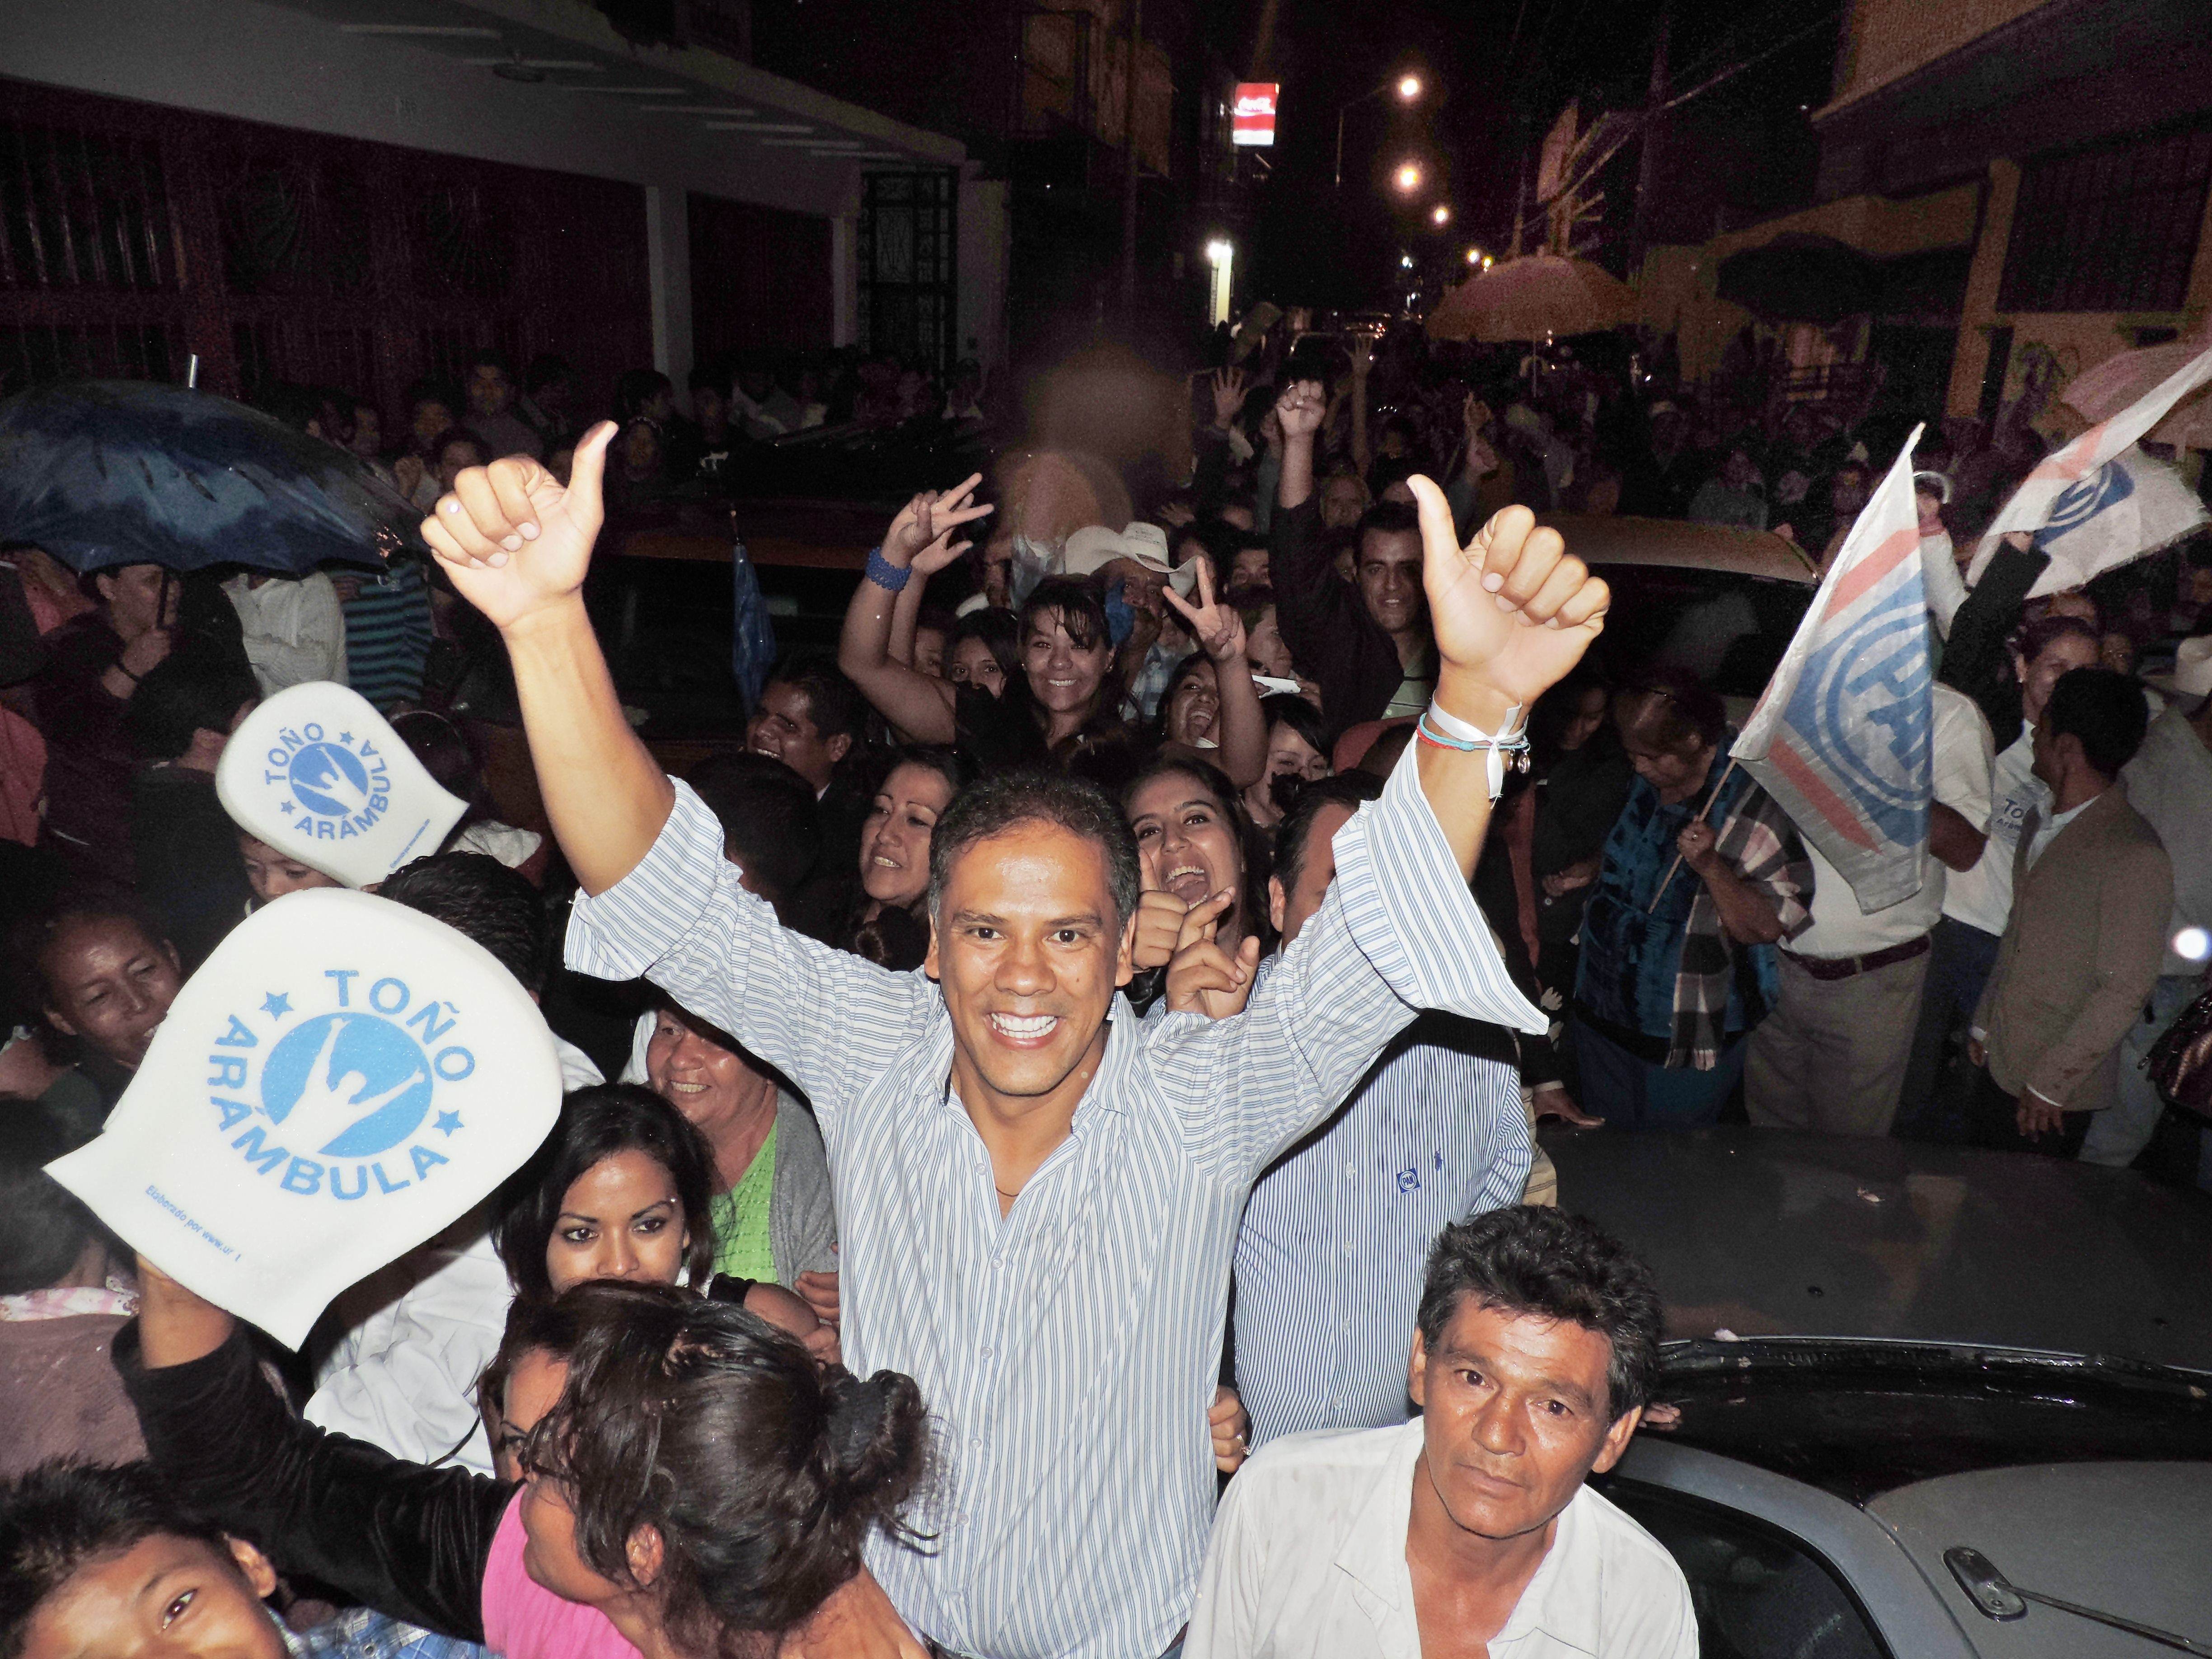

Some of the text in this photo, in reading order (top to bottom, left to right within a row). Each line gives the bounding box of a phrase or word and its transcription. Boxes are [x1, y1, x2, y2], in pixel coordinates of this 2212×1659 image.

[265, 722, 324, 785] TOÑO
[295, 740, 391, 839] ARÁMBULA
[325, 970, 475, 1081] TOÑO
[207, 1015, 450, 1200] ARÁMBULA
[146, 1185, 187, 1221] Elaborado
[184, 1219, 202, 1232] por
[1402, 1175, 1414, 1186] PAN
